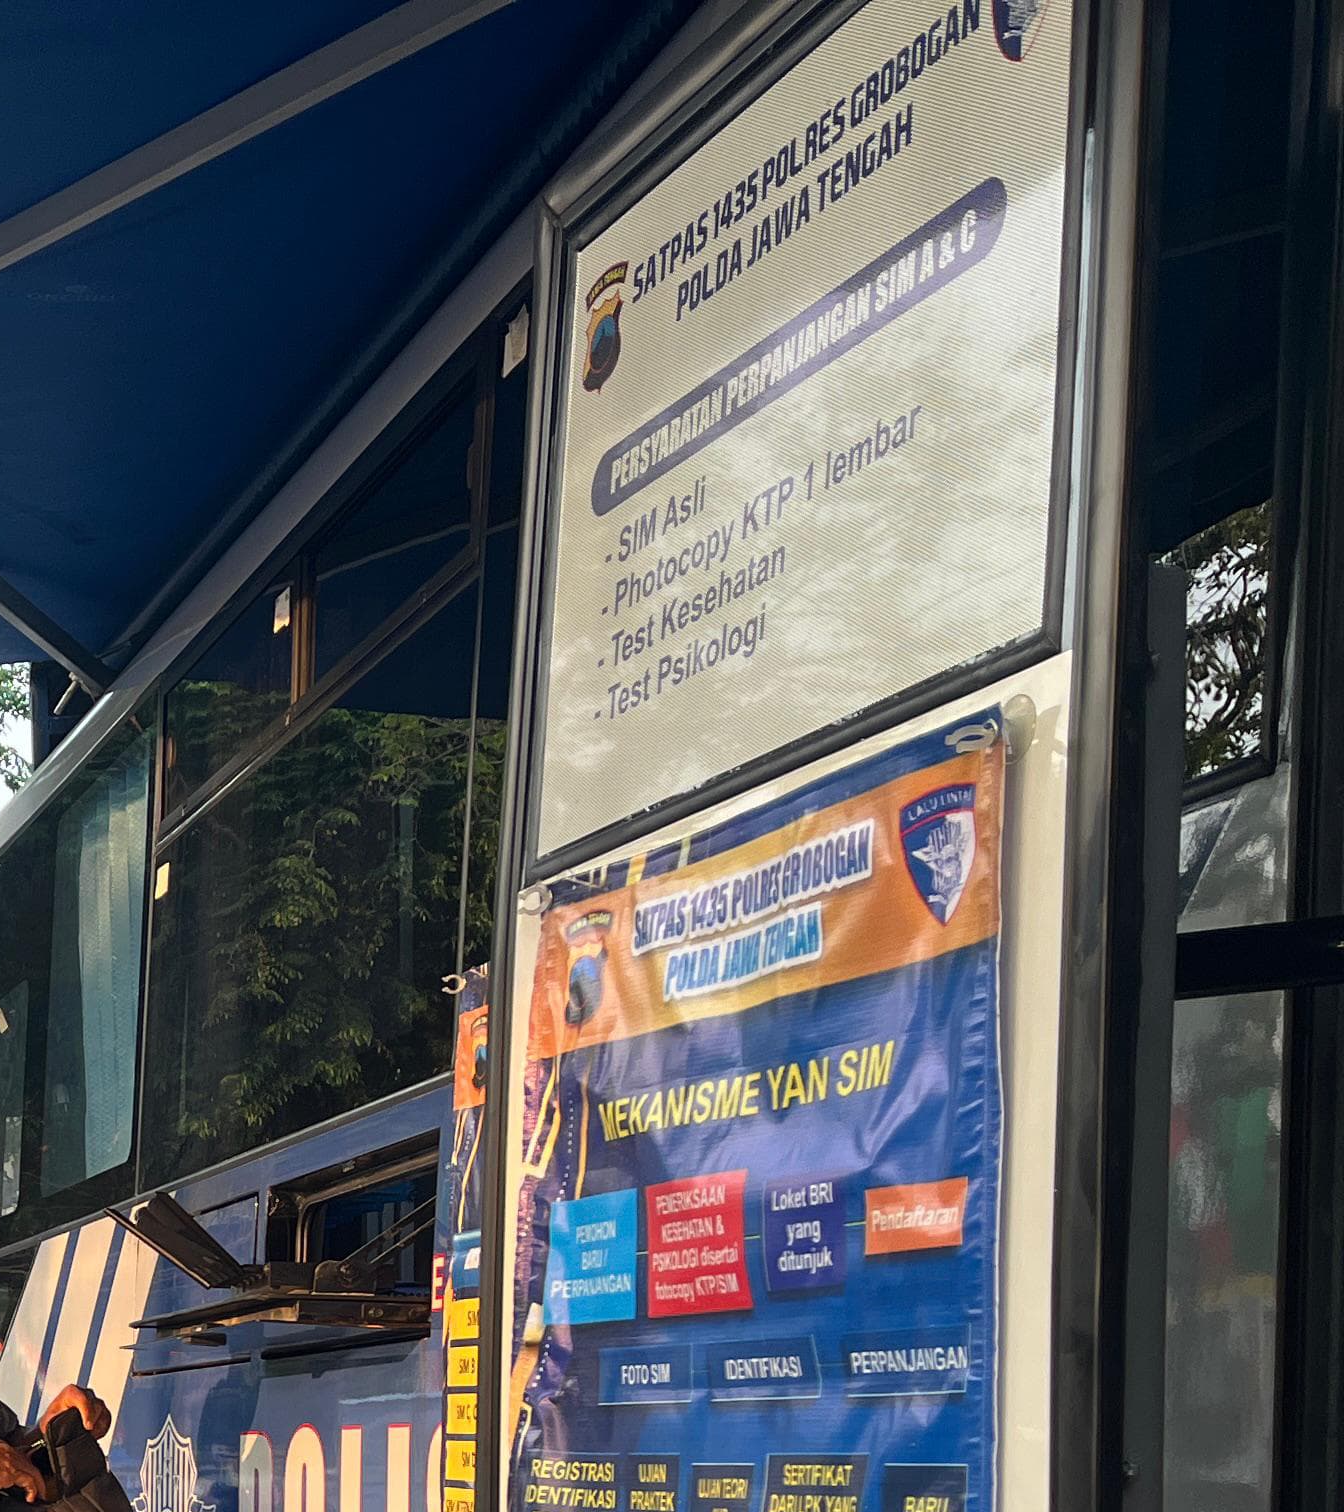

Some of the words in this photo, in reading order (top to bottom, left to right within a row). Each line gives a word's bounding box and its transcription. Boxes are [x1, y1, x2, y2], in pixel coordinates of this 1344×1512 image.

[631, 219, 707, 303] SATPAS
[712, 173, 759, 241] 1435
[761, 100, 846, 189] POLRES
[849, 1, 980, 128] GROBOGAN
[675, 252, 743, 322] POLDA
[746, 202, 811, 275] JAWA
[816, 102, 914, 213] TENGAH
[610, 393, 721, 494] PERSYARATAN
[724, 283, 872, 417] PERPANJANGAN
[873, 250, 912, 317] SIM
[913, 244, 936, 294] A
[939, 226, 958, 270] &
[958, 208, 978, 252] C
[614, 518, 734, 618] Photocopy
[741, 476, 793, 537] KTP
[802, 462, 813, 500] 1
[825, 404, 923, 490] lembar
[618, 517, 656, 562] SIM
[662, 476, 706, 536] Asli
[612, 619, 653, 668] Test
[660, 546, 786, 643] Kesehatan
[607, 674, 650, 721] Test
[657, 604, 766, 693] Psikologi
[634, 895, 685, 949] SATPAS
[690, 885, 727, 934] 1435
[731, 866, 782, 919] POLRES
[782, 824, 872, 902] GROBOGAN
[665, 945, 714, 993] POLDA
[722, 932, 759, 985] JAWA
[599, 1071, 761, 1142] MEKANISME
[766, 1056, 830, 1109] YAN
[837, 1041, 895, 1094] SIM
[771, 1187, 806, 1211] Loket
[809, 1181, 833, 1205] BRI
[662, 1217, 714, 1243] KESEHATAN
[870, 1203, 959, 1231] Pendaftaran
[786, 1219, 821, 1244] yang
[700, 1241, 739, 1267] disertai
[778, 1247, 833, 1274] ditunjuk
[655, 1278, 695, 1303] fotocopy
[724, 1355, 802, 1381] IDENTIFIKASI
[850, 1344, 969, 1375] PERPANJANGAN
[620, 1363, 650, 1386] FOTO
[651, 1362, 671, 1385] SIM
[530, 1459, 615, 1483] REGISTRASI
[639, 1463, 667, 1484] UJIAN
[783, 1463, 853, 1487] SERTIFIKAT
[525, 1483, 616, 1510] IDENTIFIKASI
[630, 1490, 676, 1512] PRAKTEK
